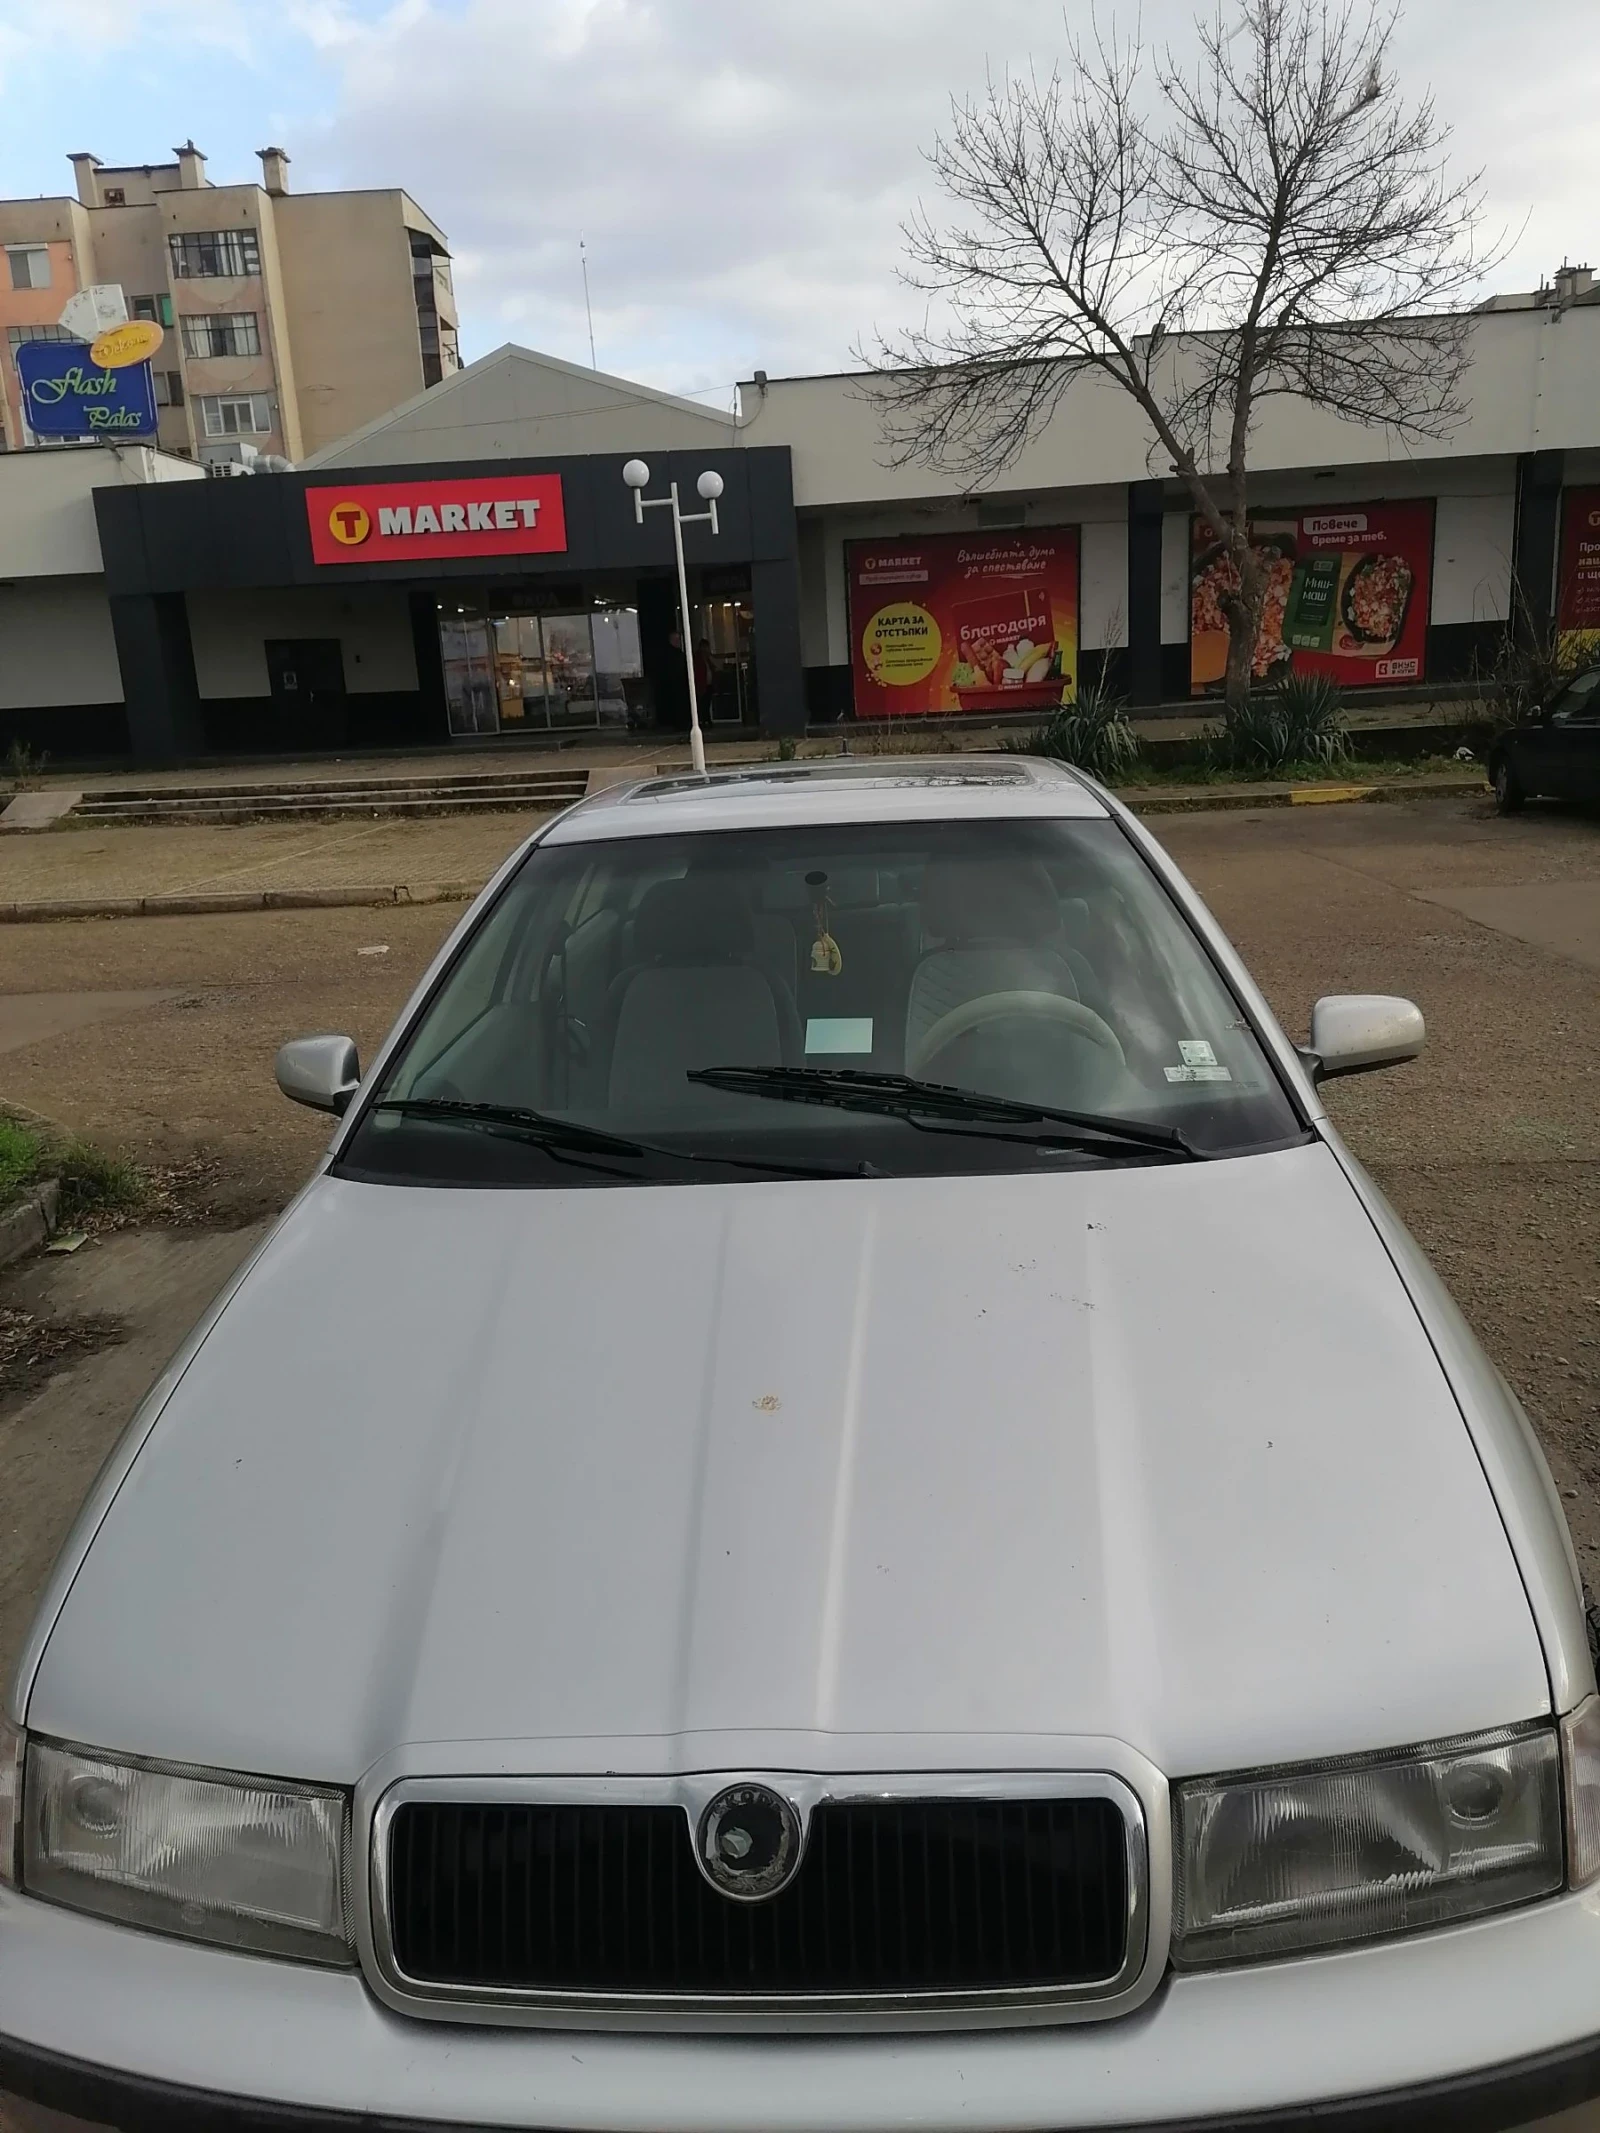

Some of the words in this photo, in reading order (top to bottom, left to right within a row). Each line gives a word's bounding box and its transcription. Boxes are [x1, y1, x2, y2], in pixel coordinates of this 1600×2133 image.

[83, 405, 143, 429] Palas
[378, 499, 541, 535] MARKET
[1312, 519, 1358, 532] Повече
[1312, 536, 1346, 547] време
[1347, 535, 1360, 545] за
[1361, 531, 1388, 542] теб.
[957, 548, 1026, 563] Вълшебната
[1029, 545, 1056, 561] дума
[878, 556, 922, 567] MARKET
[964, 565, 980, 579] за
[982, 558, 1047, 573] спестяване
[1305, 577, 1334, 589] Миш-
[1302, 590, 1327, 601] маш
[877, 616, 911, 627] КАРТА
[912, 615, 925, 625] ЗА
[959, 615, 1047, 641] благодаря
[875, 626, 929, 638] ОТСТЪПКИ
